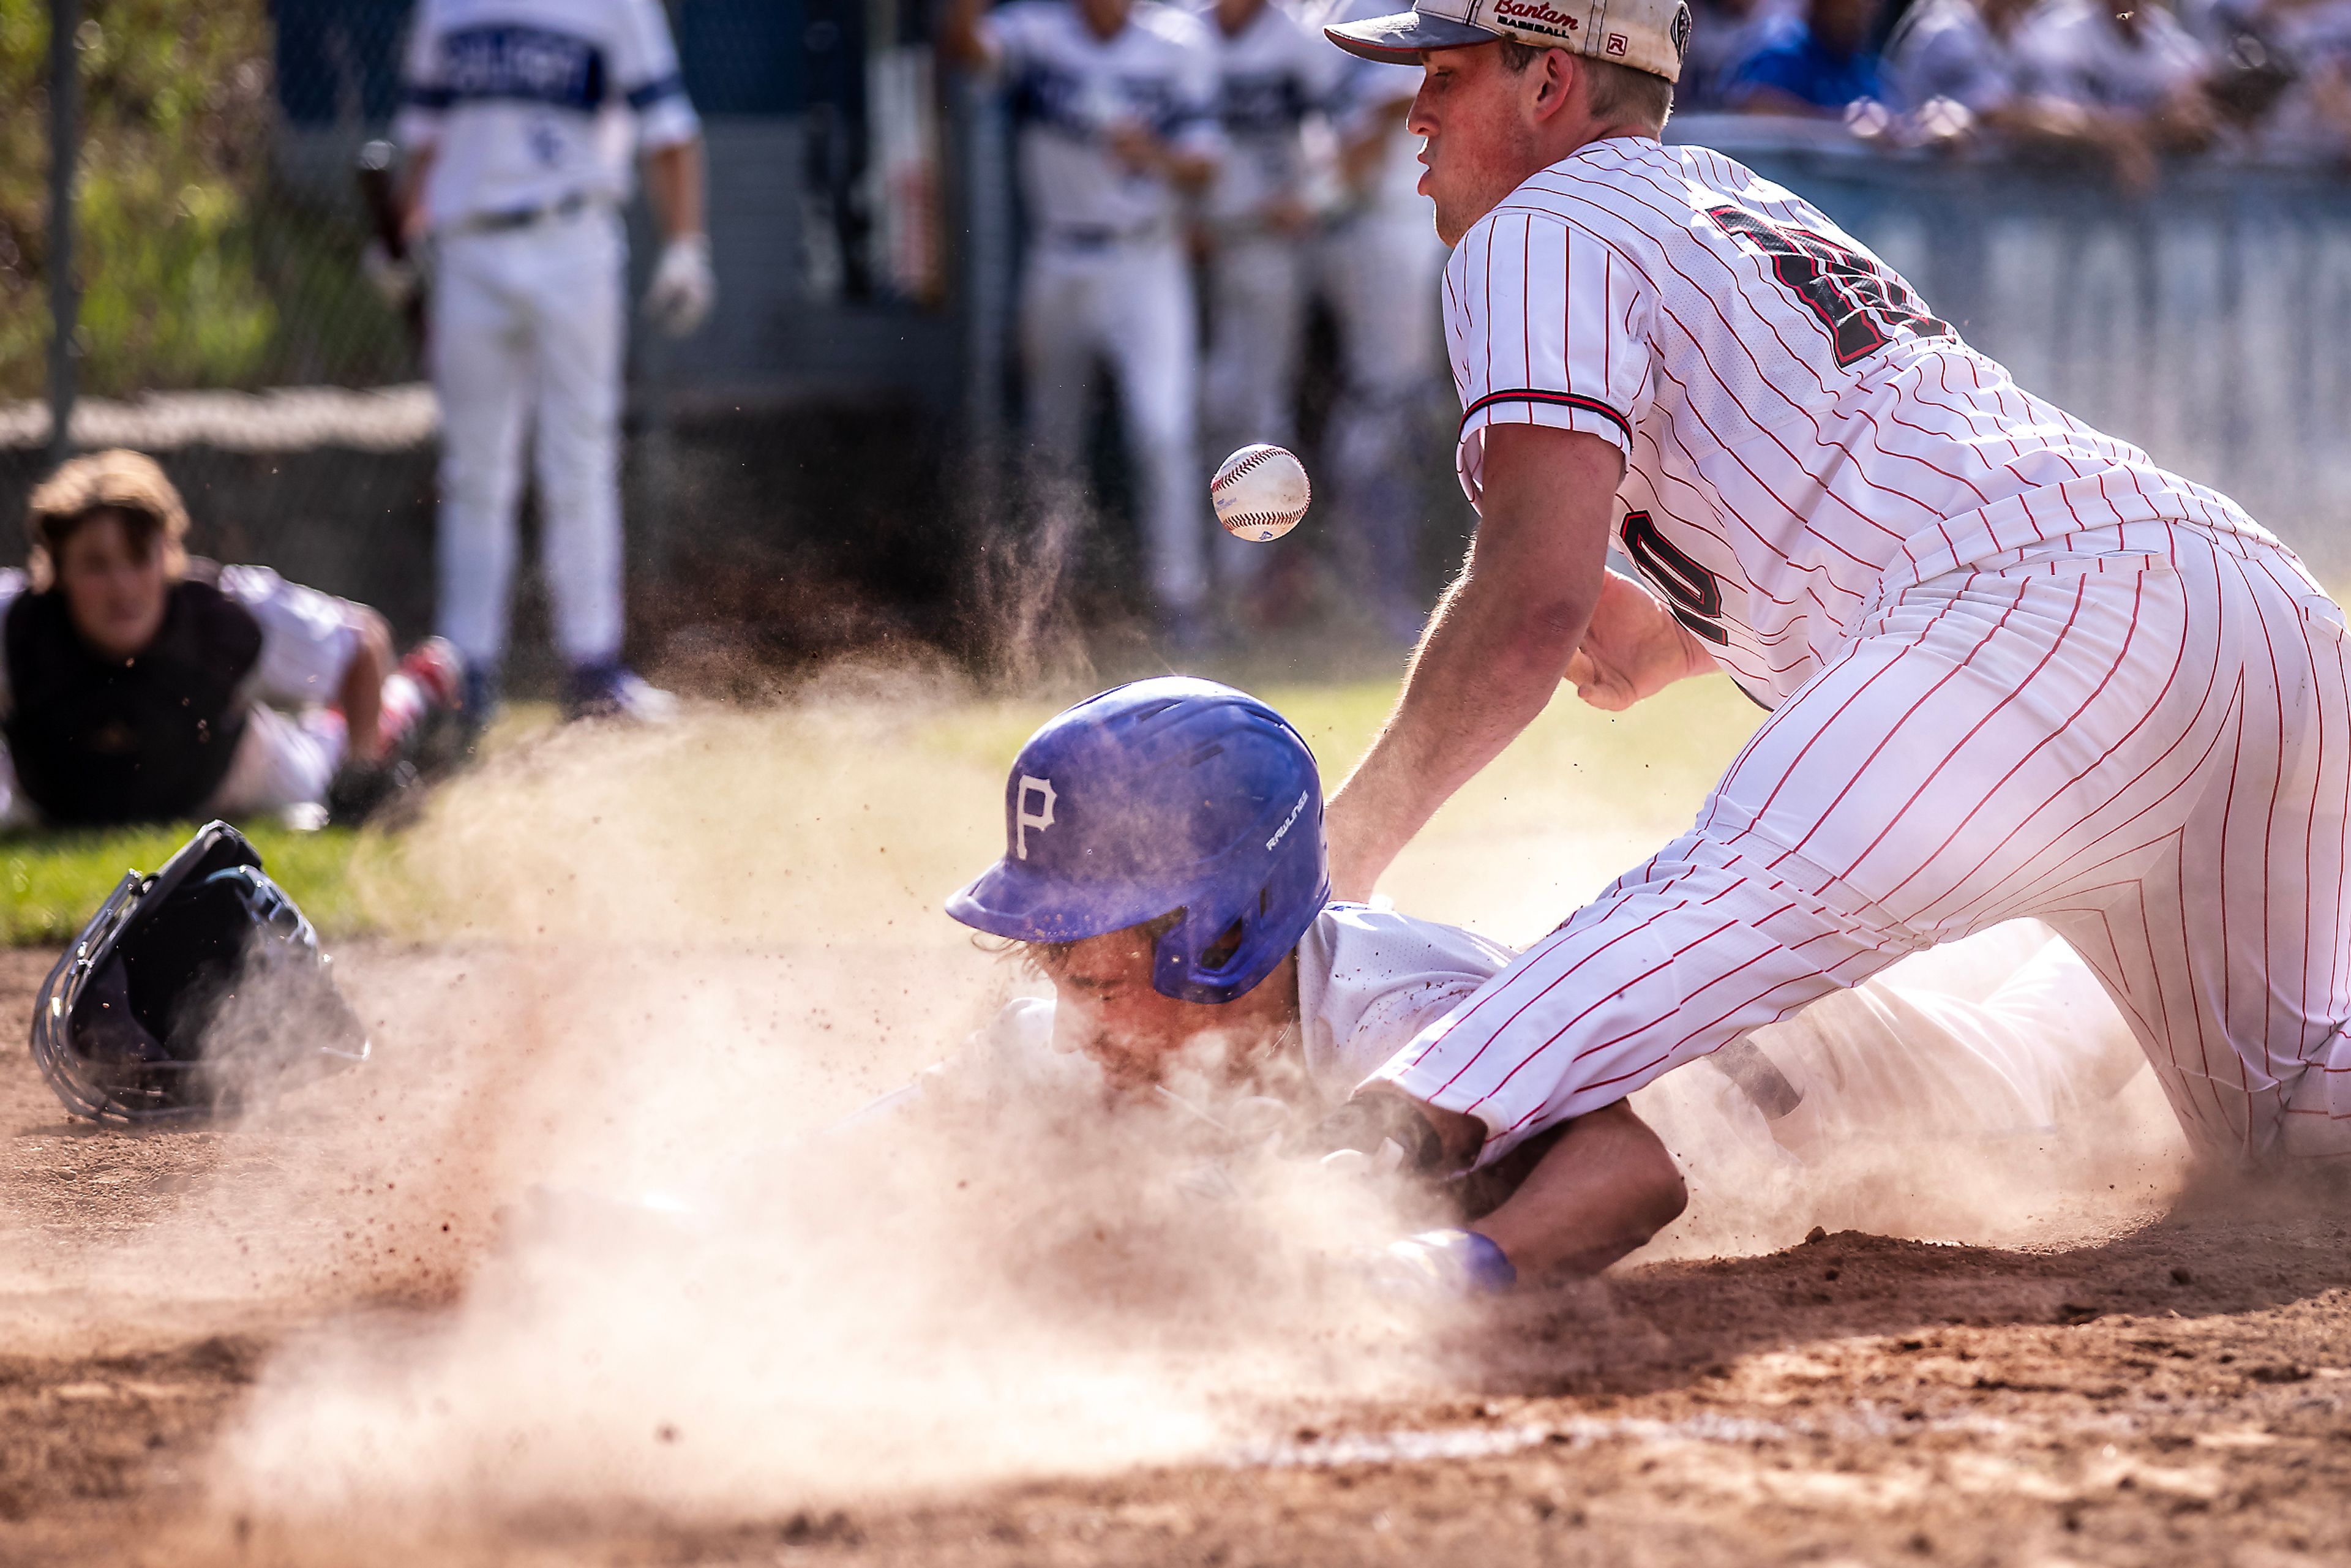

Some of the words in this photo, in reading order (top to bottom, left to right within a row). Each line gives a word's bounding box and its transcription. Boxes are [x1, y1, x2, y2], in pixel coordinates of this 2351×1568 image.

[1493, 0, 1579, 30] Bantam
[1496, 14, 1570, 39] BASEBALL
[1016, 774, 1057, 861] P
[1265, 789, 1309, 851] RAWLINGS
